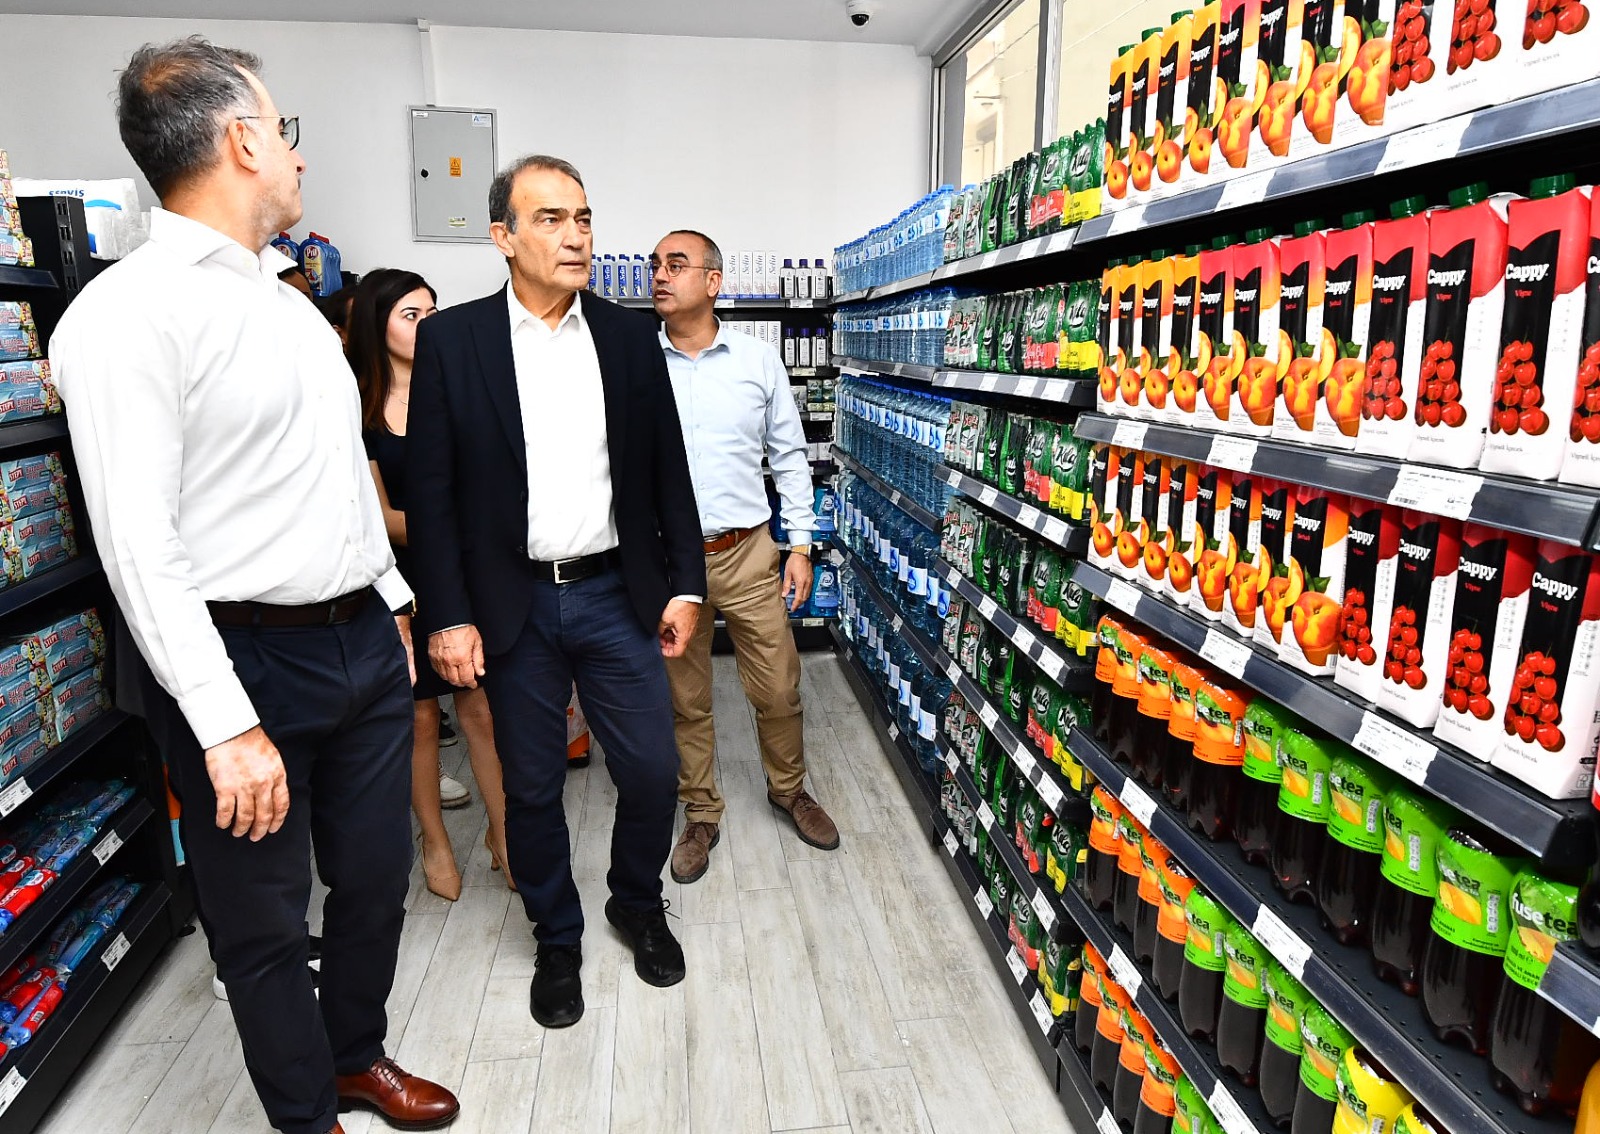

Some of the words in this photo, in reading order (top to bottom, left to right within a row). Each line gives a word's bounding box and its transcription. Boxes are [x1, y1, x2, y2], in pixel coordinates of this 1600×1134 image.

[1260, 6, 1284, 26] Cappy
[1219, 28, 1240, 46] Cappy
[1190, 45, 1211, 62] Cappy
[1427, 269, 1466, 287] Cappy
[1505, 263, 1549, 282] Cappy
[1280, 285, 1304, 299] Cappy
[1325, 281, 1351, 295] Cappy
[1373, 275, 1406, 291] Cappy
[1200, 292, 1222, 304] Cappy
[1234, 289, 1258, 302] Cappy
[1230, 494, 1247, 509] Cappy
[1261, 504, 1282, 520] Cappy
[1294, 513, 1321, 532] Cappy
[1348, 526, 1375, 546] Cappy
[1398, 538, 1431, 561] Cappy
[1458, 556, 1497, 580] Cappy
[1532, 572, 1578, 600] Cappy
